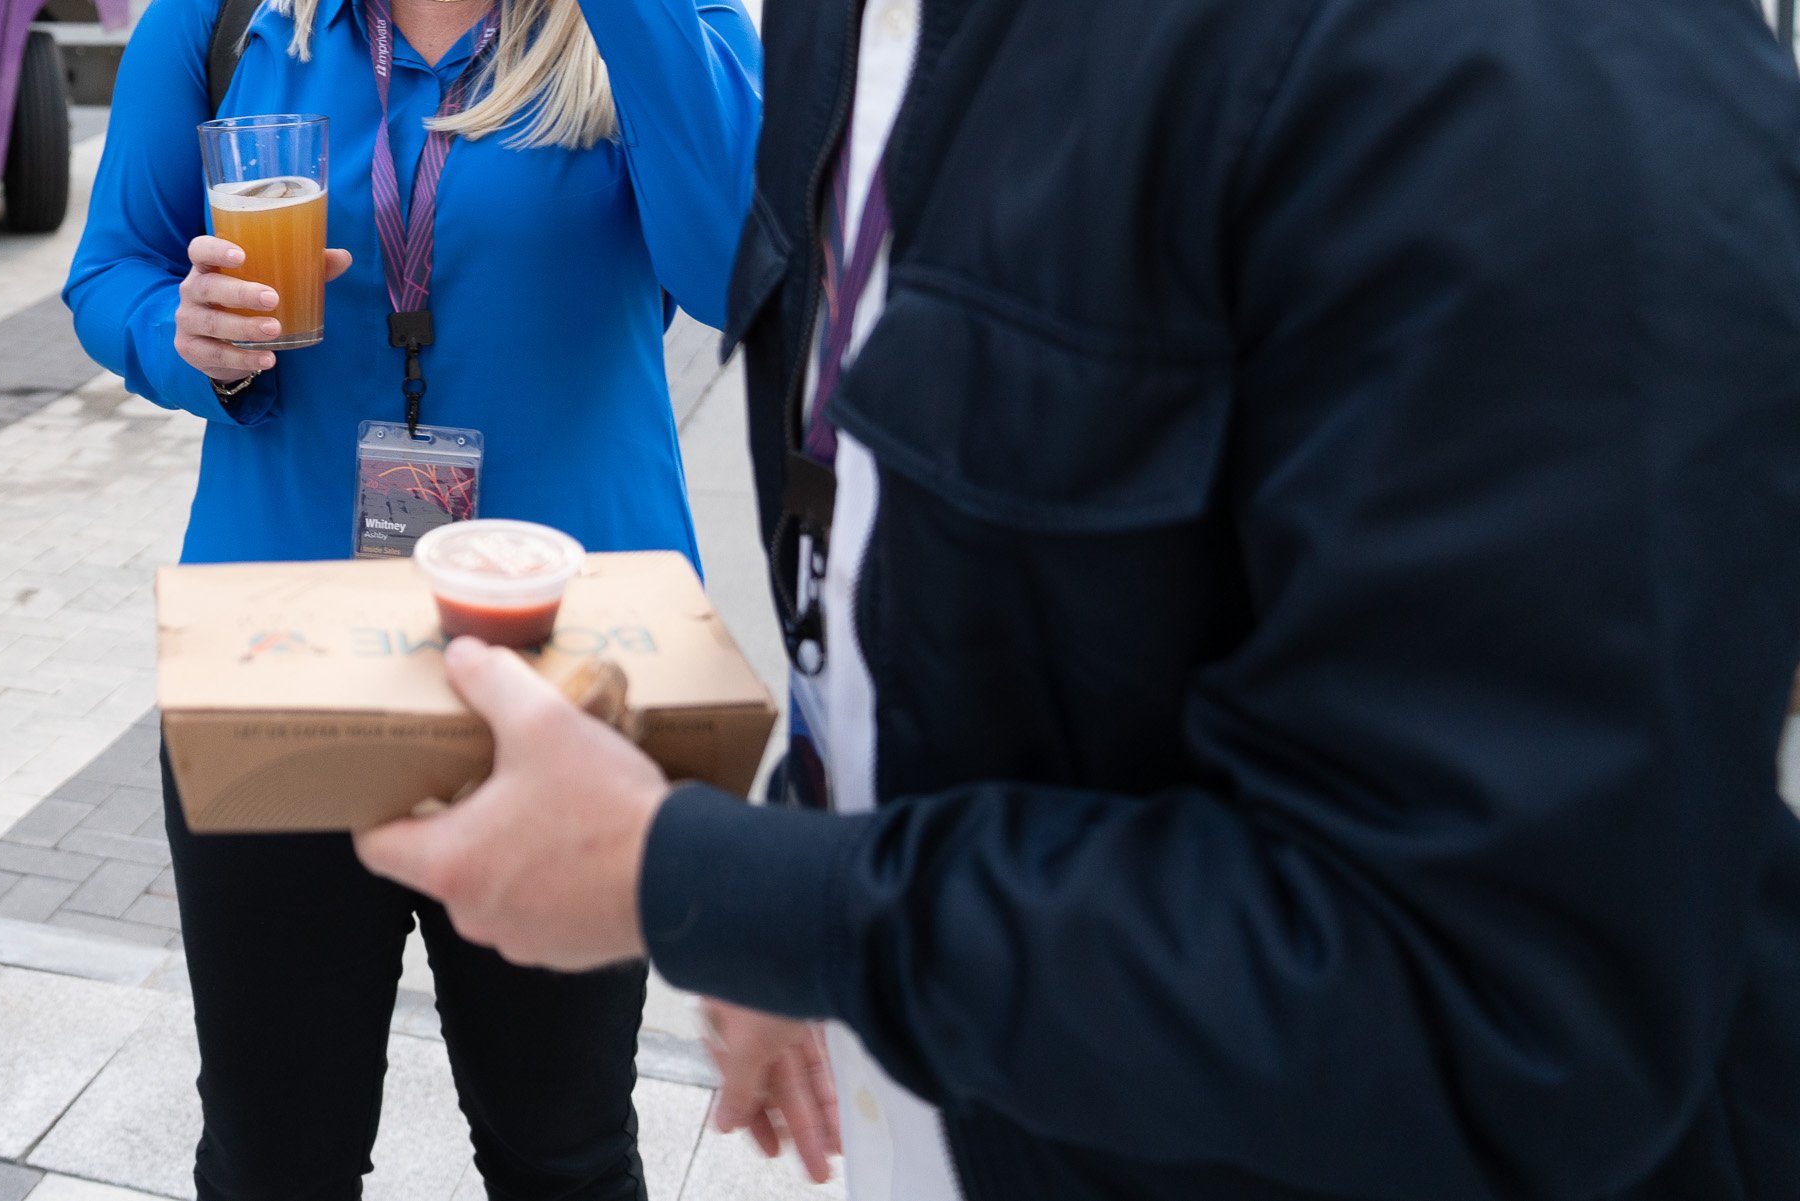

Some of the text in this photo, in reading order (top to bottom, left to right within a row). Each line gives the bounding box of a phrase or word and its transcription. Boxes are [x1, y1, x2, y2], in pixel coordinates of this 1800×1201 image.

[375, 19, 390, 65] imprivata
[365, 517, 407, 533] Whitney
[364, 531, 388, 540] Ashby
